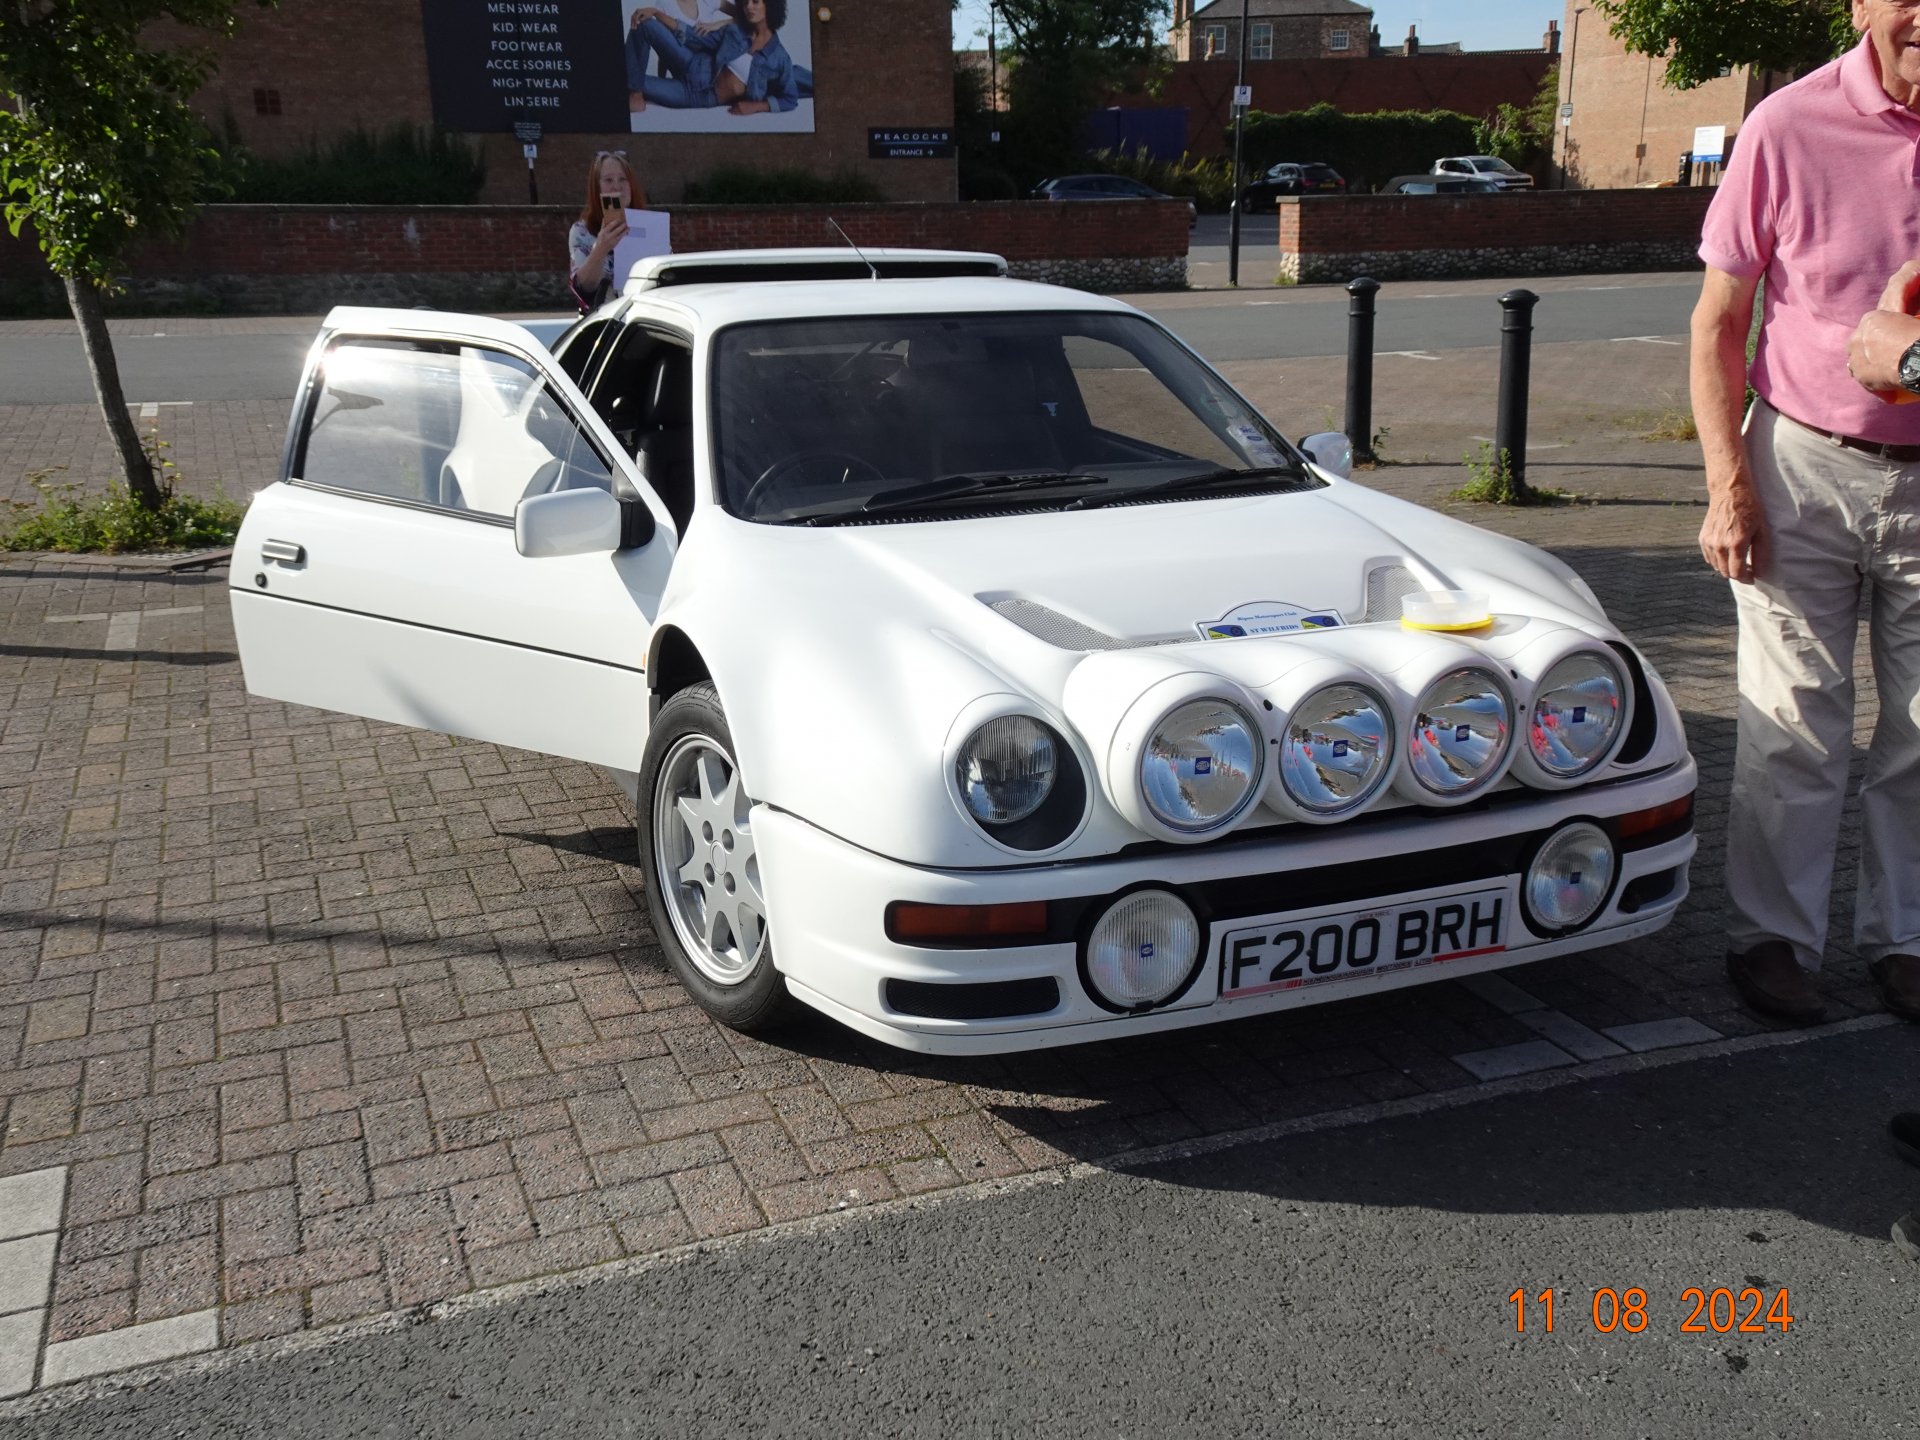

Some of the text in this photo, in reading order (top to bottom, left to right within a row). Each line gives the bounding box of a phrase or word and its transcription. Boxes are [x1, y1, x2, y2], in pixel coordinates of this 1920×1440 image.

[492, 22, 558, 33] KIDWEAR
[491, 41, 562, 52] FOOTWEAR
[1260, 624, 1299, 634] WILFRIDS
[1231, 898, 1503, 989] F200 BRH
